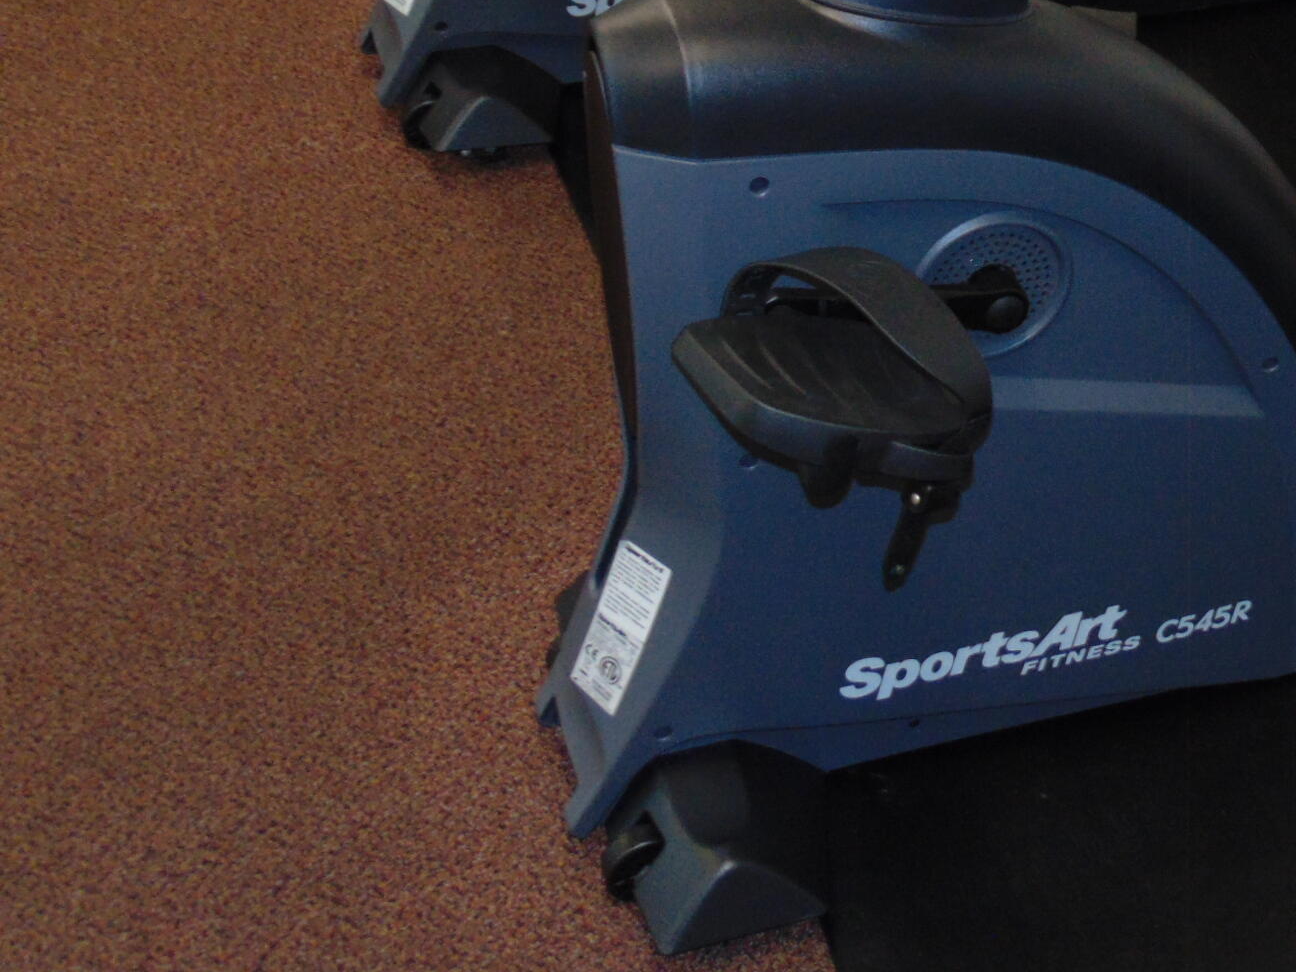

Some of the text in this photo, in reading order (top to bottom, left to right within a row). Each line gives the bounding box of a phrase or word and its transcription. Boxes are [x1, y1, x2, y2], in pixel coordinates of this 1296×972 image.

[839, 604, 1127, 701] SportsArt
[1021, 600, 1252, 676] FITNESS C545R
